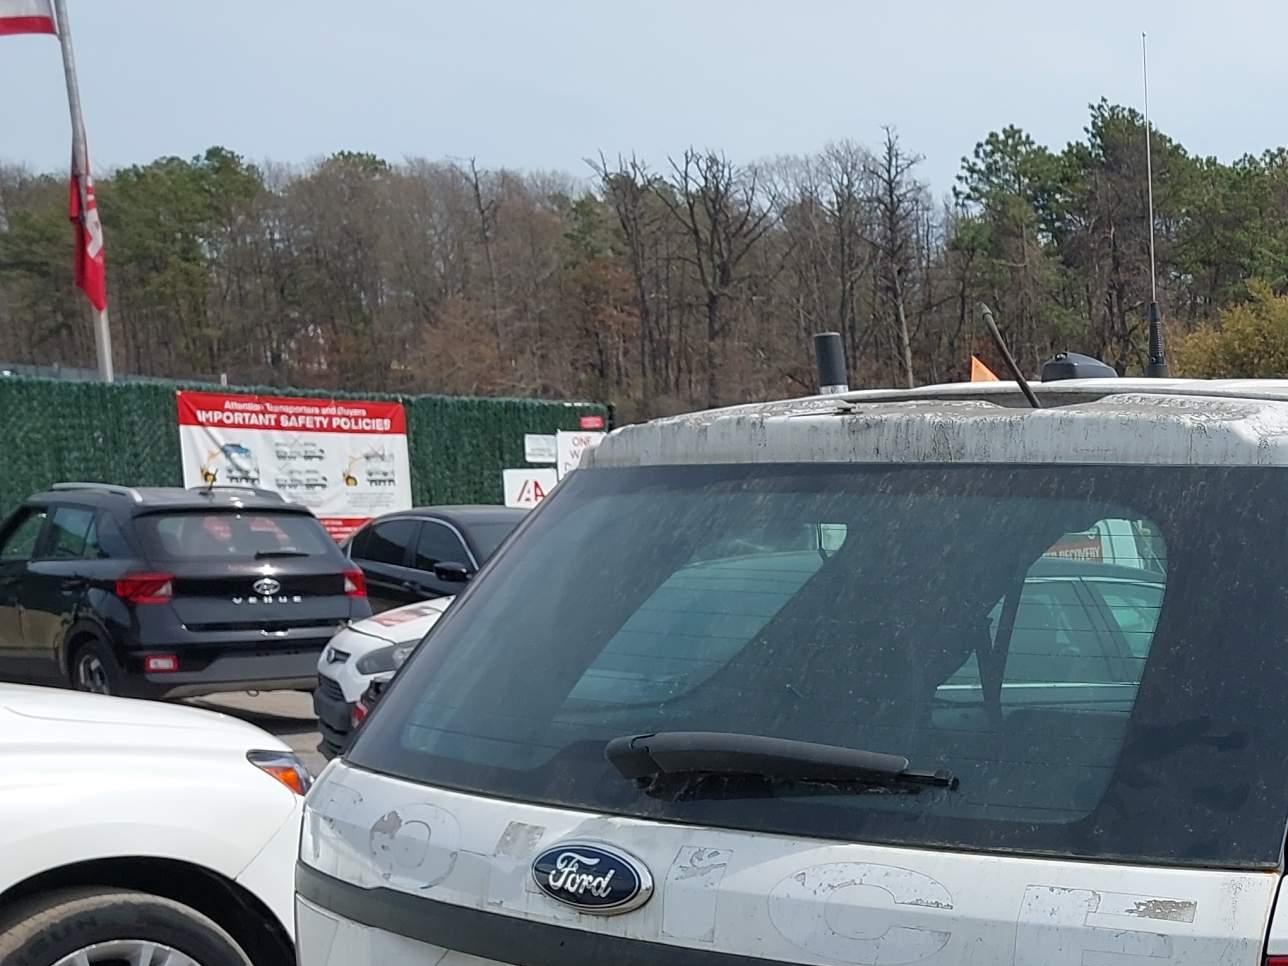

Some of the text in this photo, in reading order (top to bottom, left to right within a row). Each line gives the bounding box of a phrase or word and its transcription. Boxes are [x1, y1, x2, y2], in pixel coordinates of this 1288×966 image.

[196, 410, 391, 431] IMPORTANT SAFETY POLICIES
[232, 595, 302, 604] VENUE
[549, 852, 615, 897] Ford
